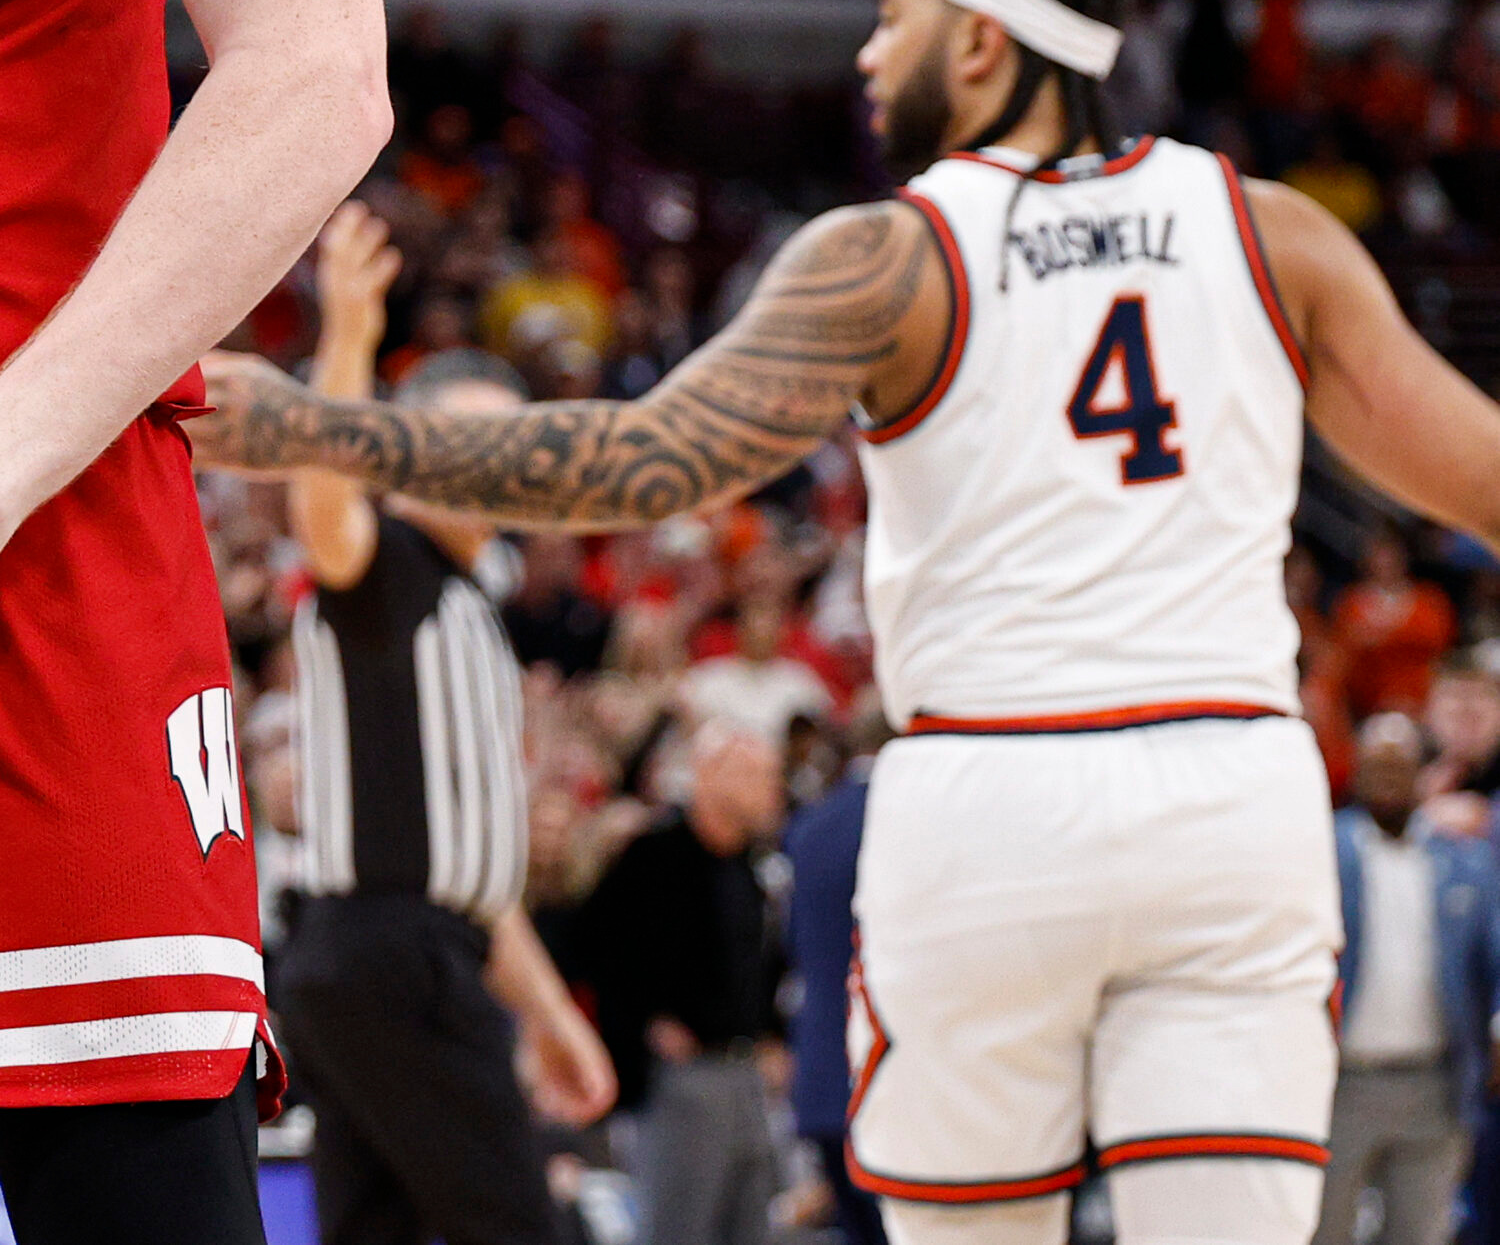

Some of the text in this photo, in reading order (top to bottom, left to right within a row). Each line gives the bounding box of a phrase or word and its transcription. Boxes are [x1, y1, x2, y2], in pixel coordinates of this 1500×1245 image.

[1008, 210, 1182, 280] BOSWELL
[1064, 292, 1185, 486] 4
[165, 685, 246, 864] W
